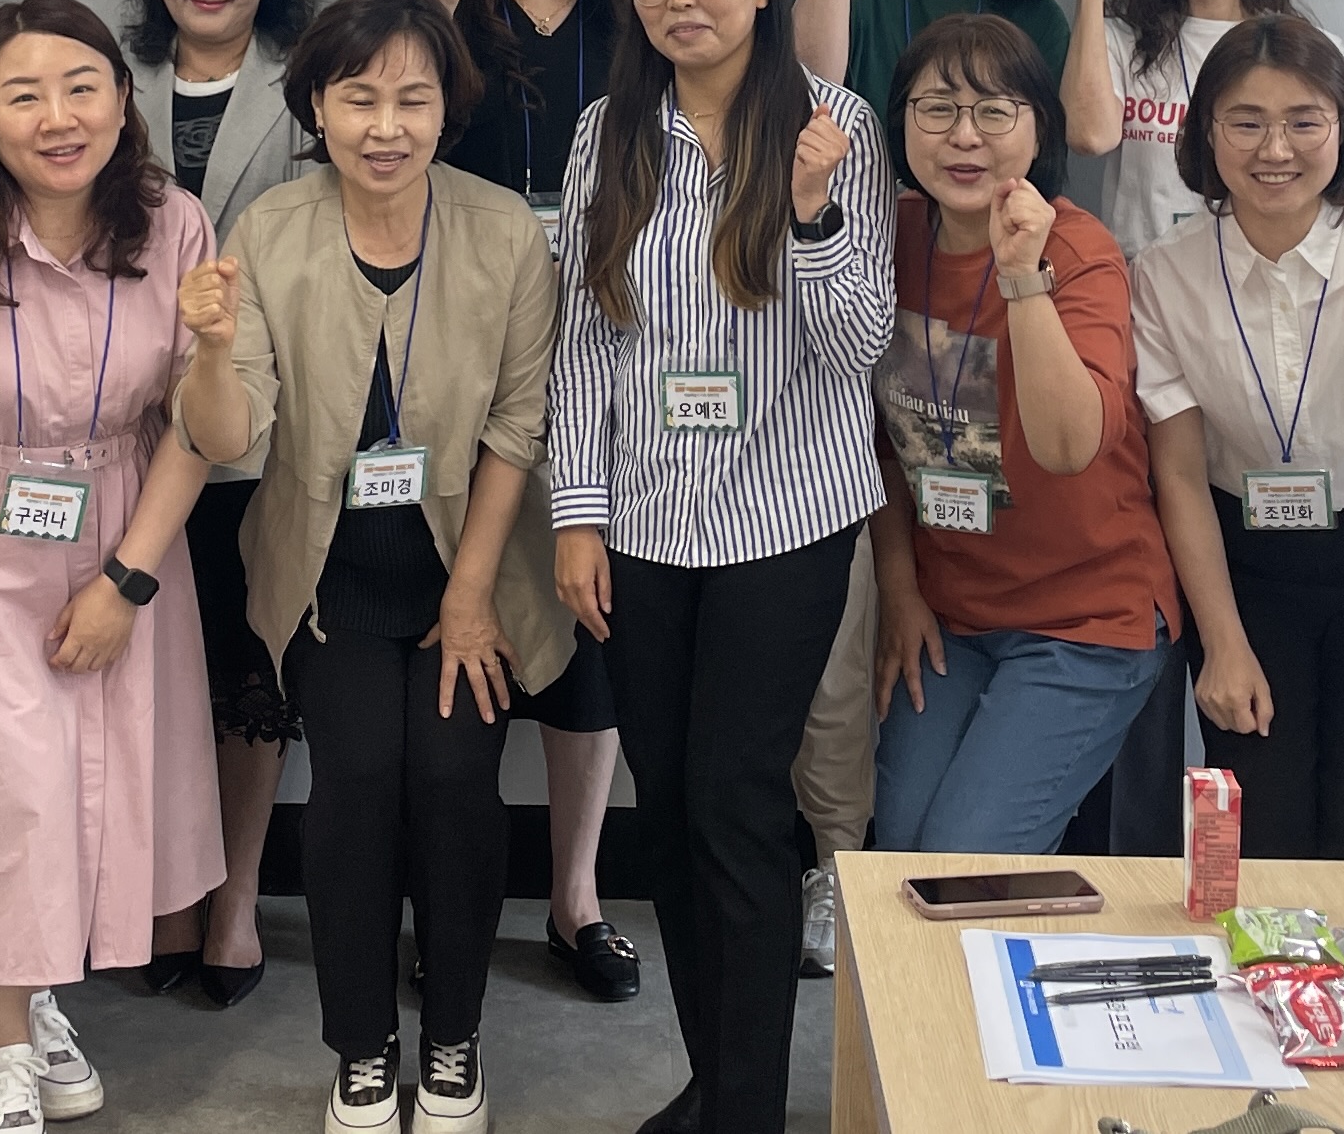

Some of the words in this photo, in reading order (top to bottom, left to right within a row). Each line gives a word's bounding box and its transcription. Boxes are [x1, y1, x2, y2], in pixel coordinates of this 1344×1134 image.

[1123, 129, 1153, 142] SAINT
[1157, 132, 1180, 144] GE
[677, 401, 727, 420] 오예진
[363, 477, 412, 497] 조미경
[15, 506, 68, 530] 구려나
[934, 503, 975, 524] 임기숙
[1264, 504, 1314, 521] 조민화
